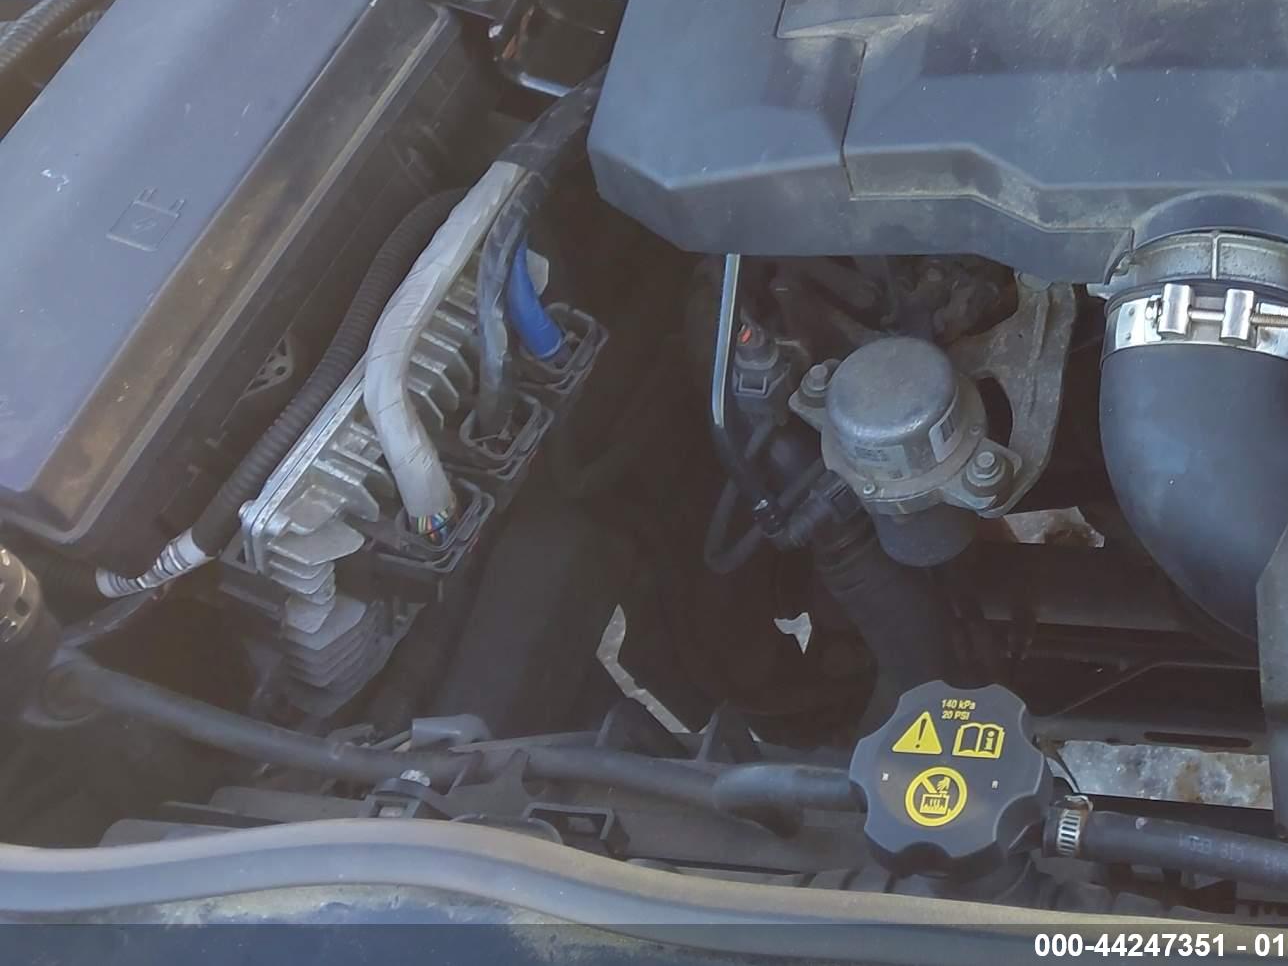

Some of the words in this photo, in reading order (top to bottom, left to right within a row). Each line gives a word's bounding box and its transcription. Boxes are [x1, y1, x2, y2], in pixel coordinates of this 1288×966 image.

[941, 699, 957, 709] 140
[958, 700, 976, 710] kPa
[941, 710, 953, 720] 20
[954, 710, 970, 721] PSI
